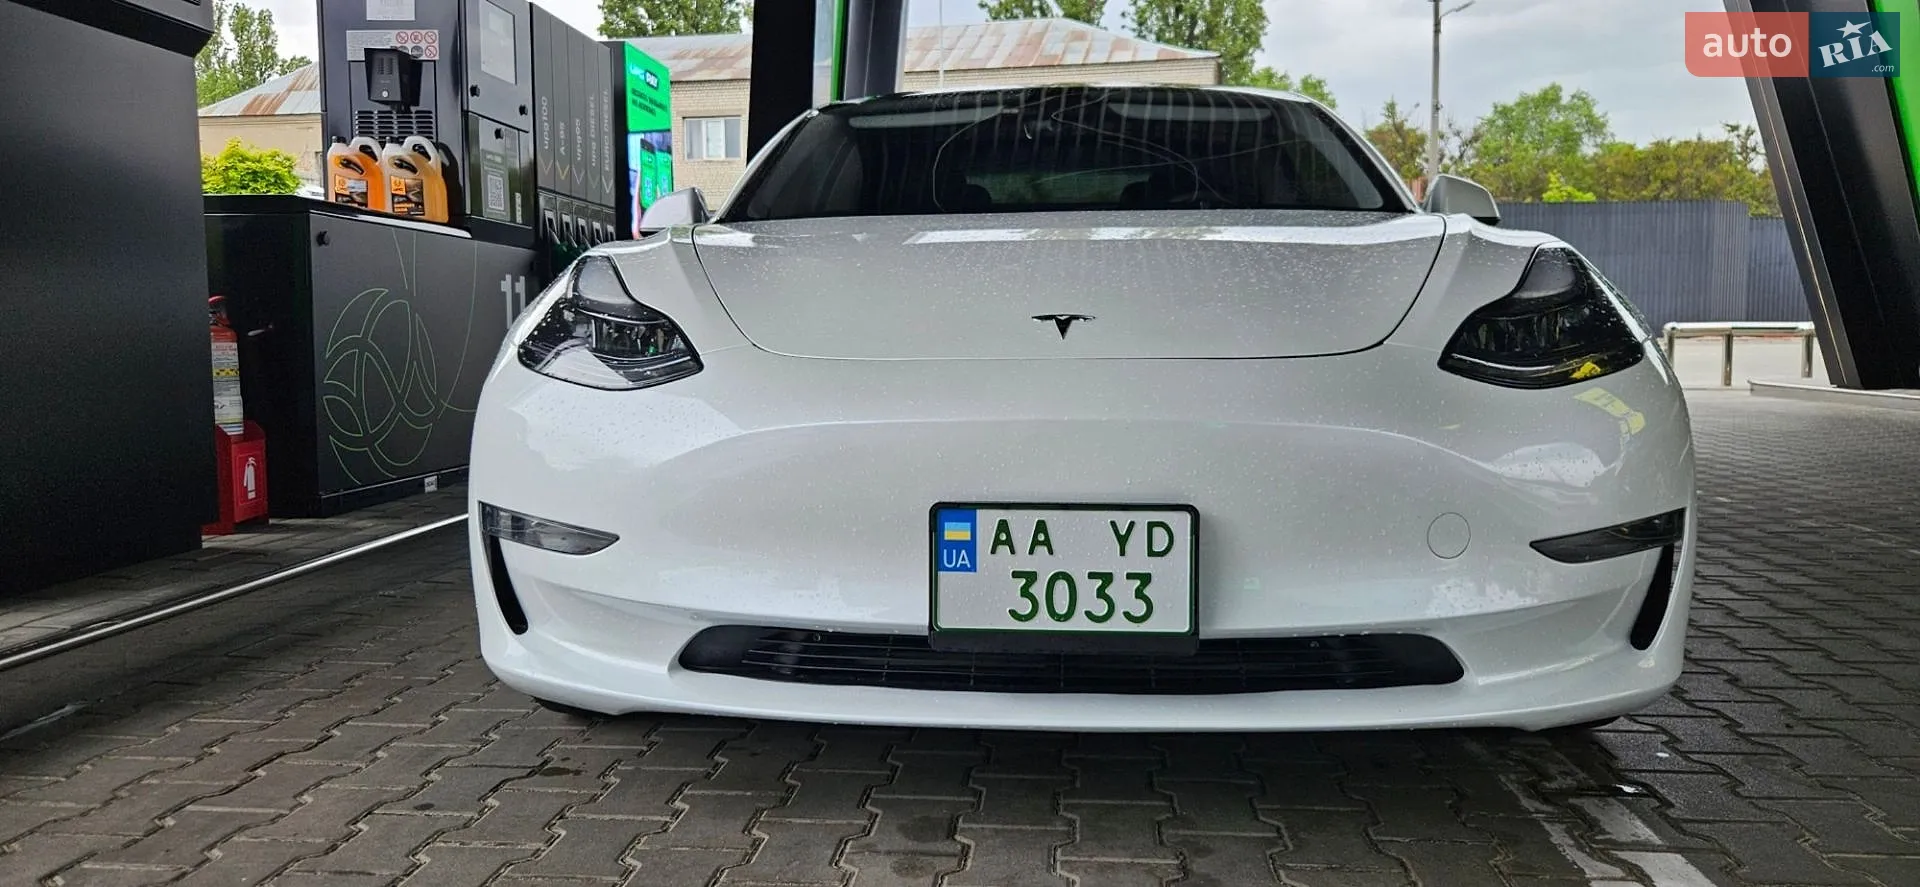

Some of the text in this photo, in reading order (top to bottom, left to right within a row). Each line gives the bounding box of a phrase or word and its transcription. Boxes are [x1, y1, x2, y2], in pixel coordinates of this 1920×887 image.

[541, 96, 550, 150] upg100
[501, 274, 526, 329] 11
[943, 549, 971, 568] UA
[990, 519, 1175, 557] AA YD
[1008, 570, 1154, 623] 3033
